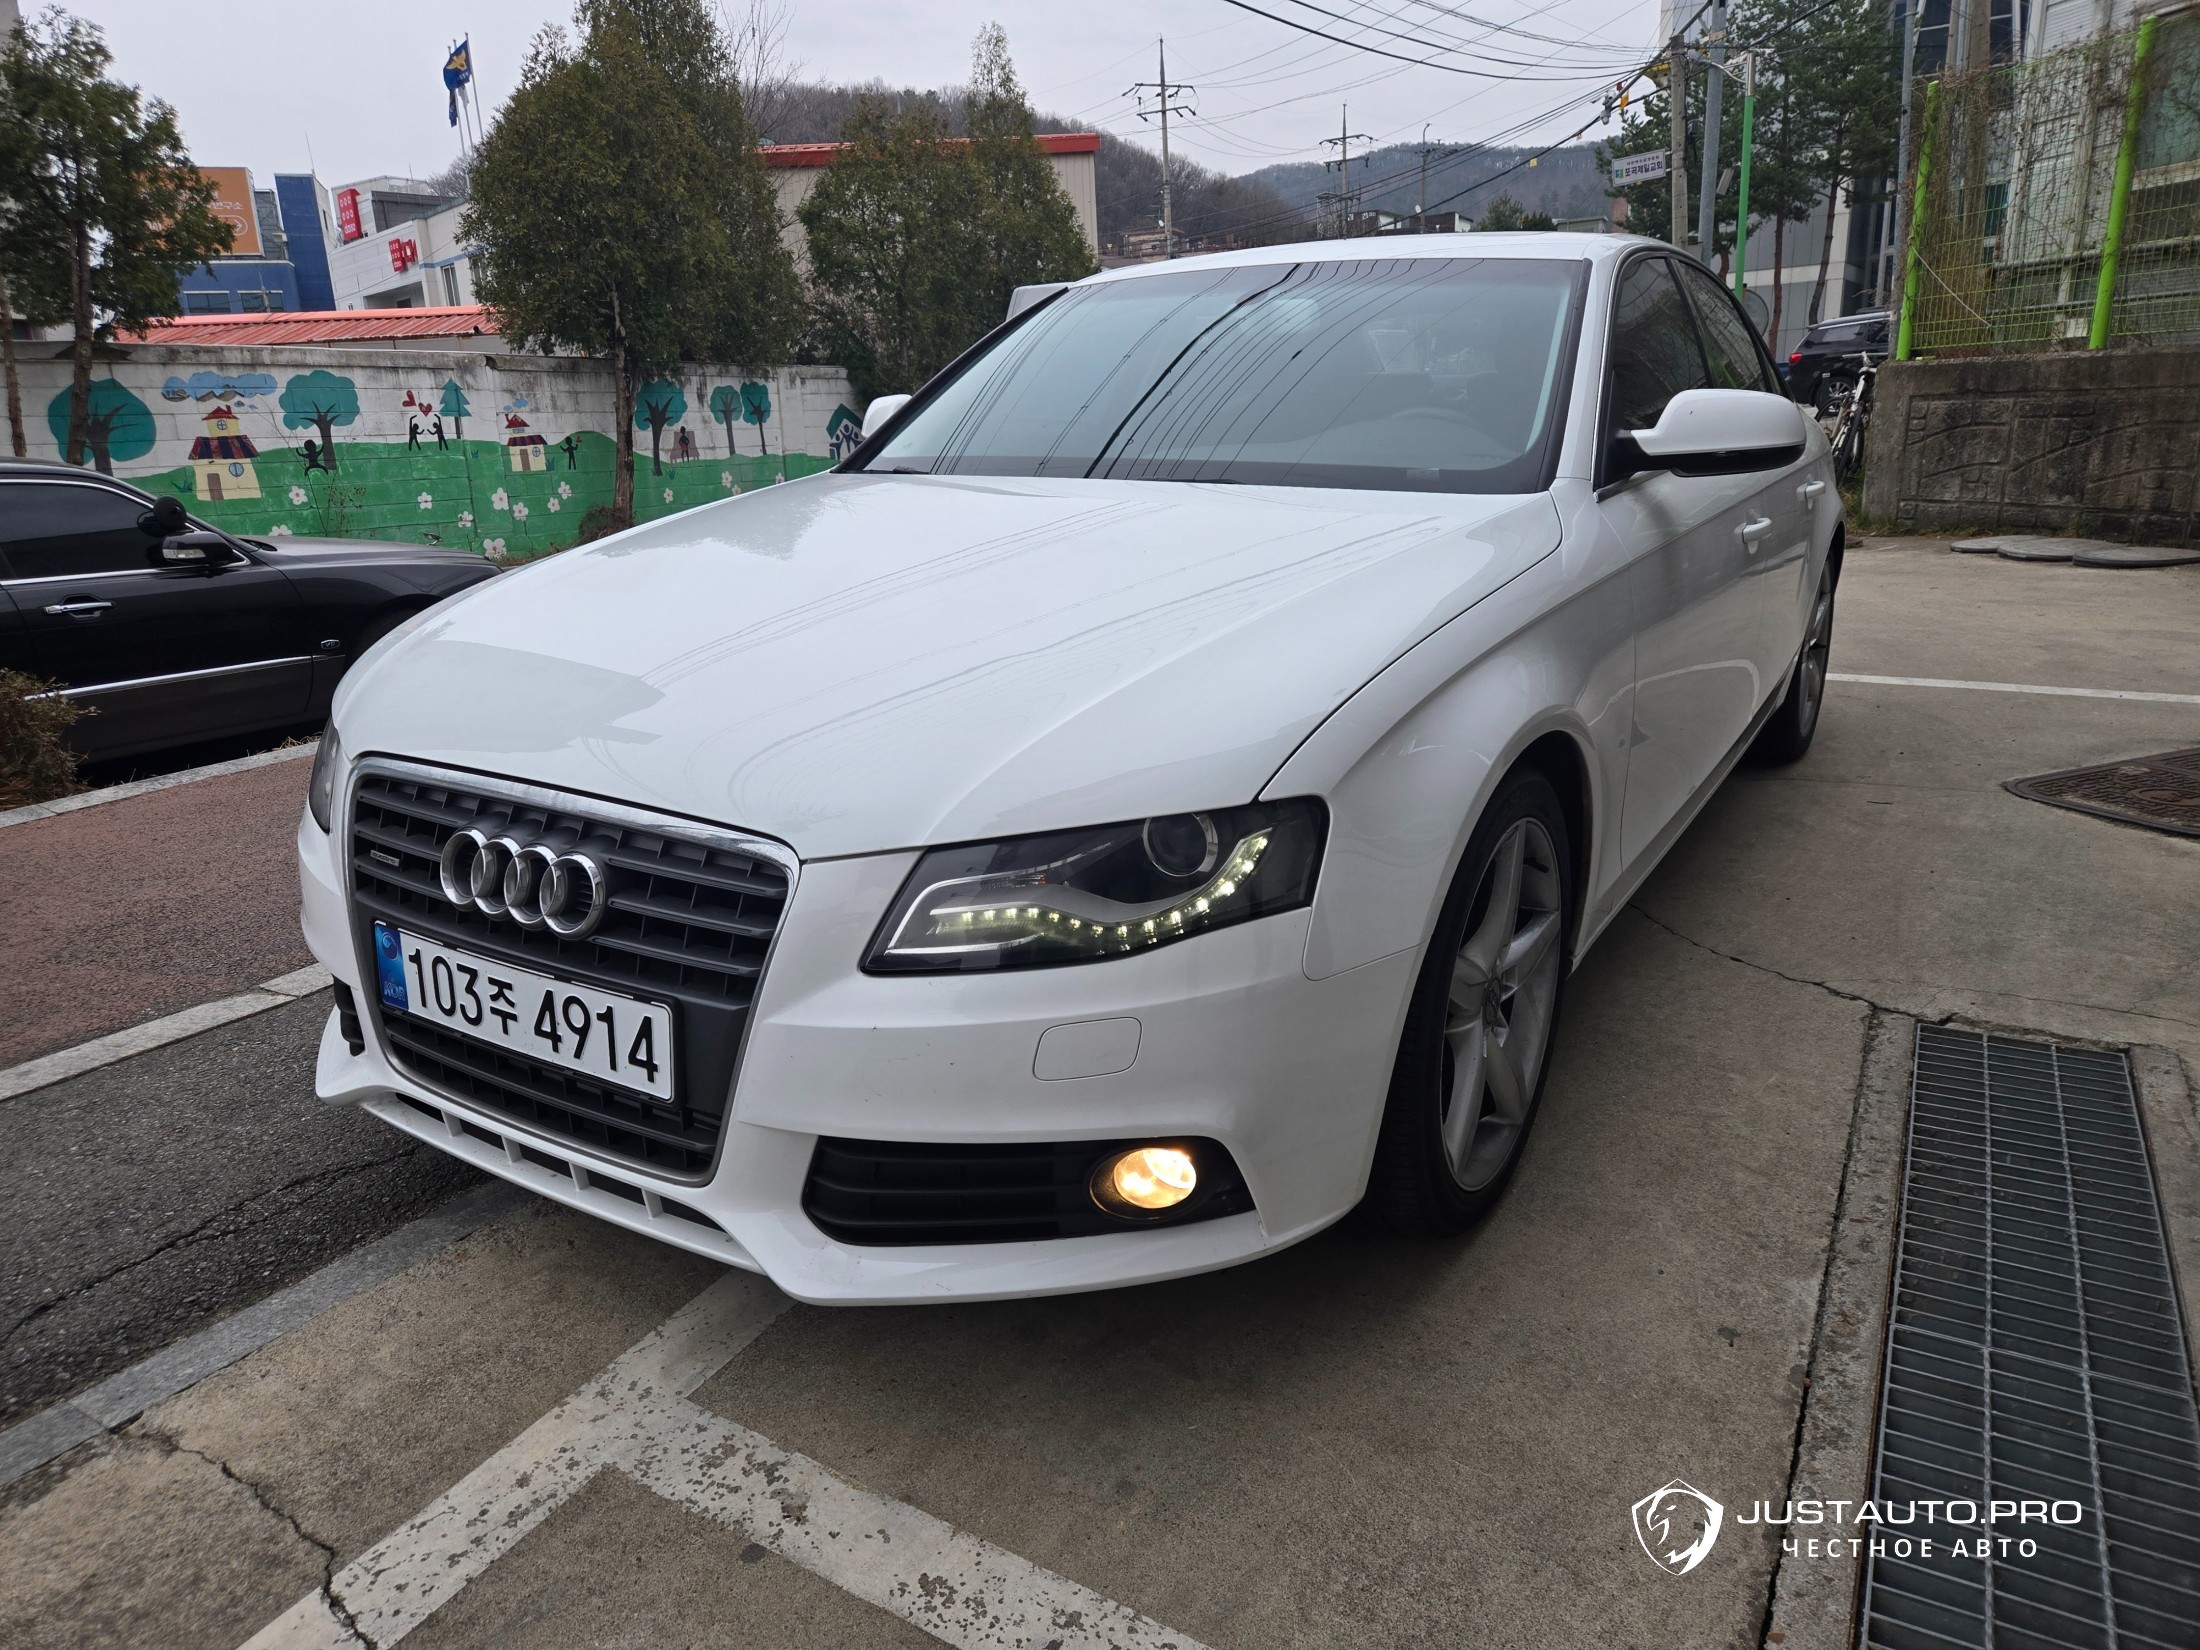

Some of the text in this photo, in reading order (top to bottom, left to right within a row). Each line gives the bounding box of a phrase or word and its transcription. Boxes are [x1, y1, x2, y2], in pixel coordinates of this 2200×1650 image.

[1625, 160, 1663, 177] 포곡제일교회
[384, 981, 406, 1001] KOR
[408, 947, 659, 1083] 103주 4914
